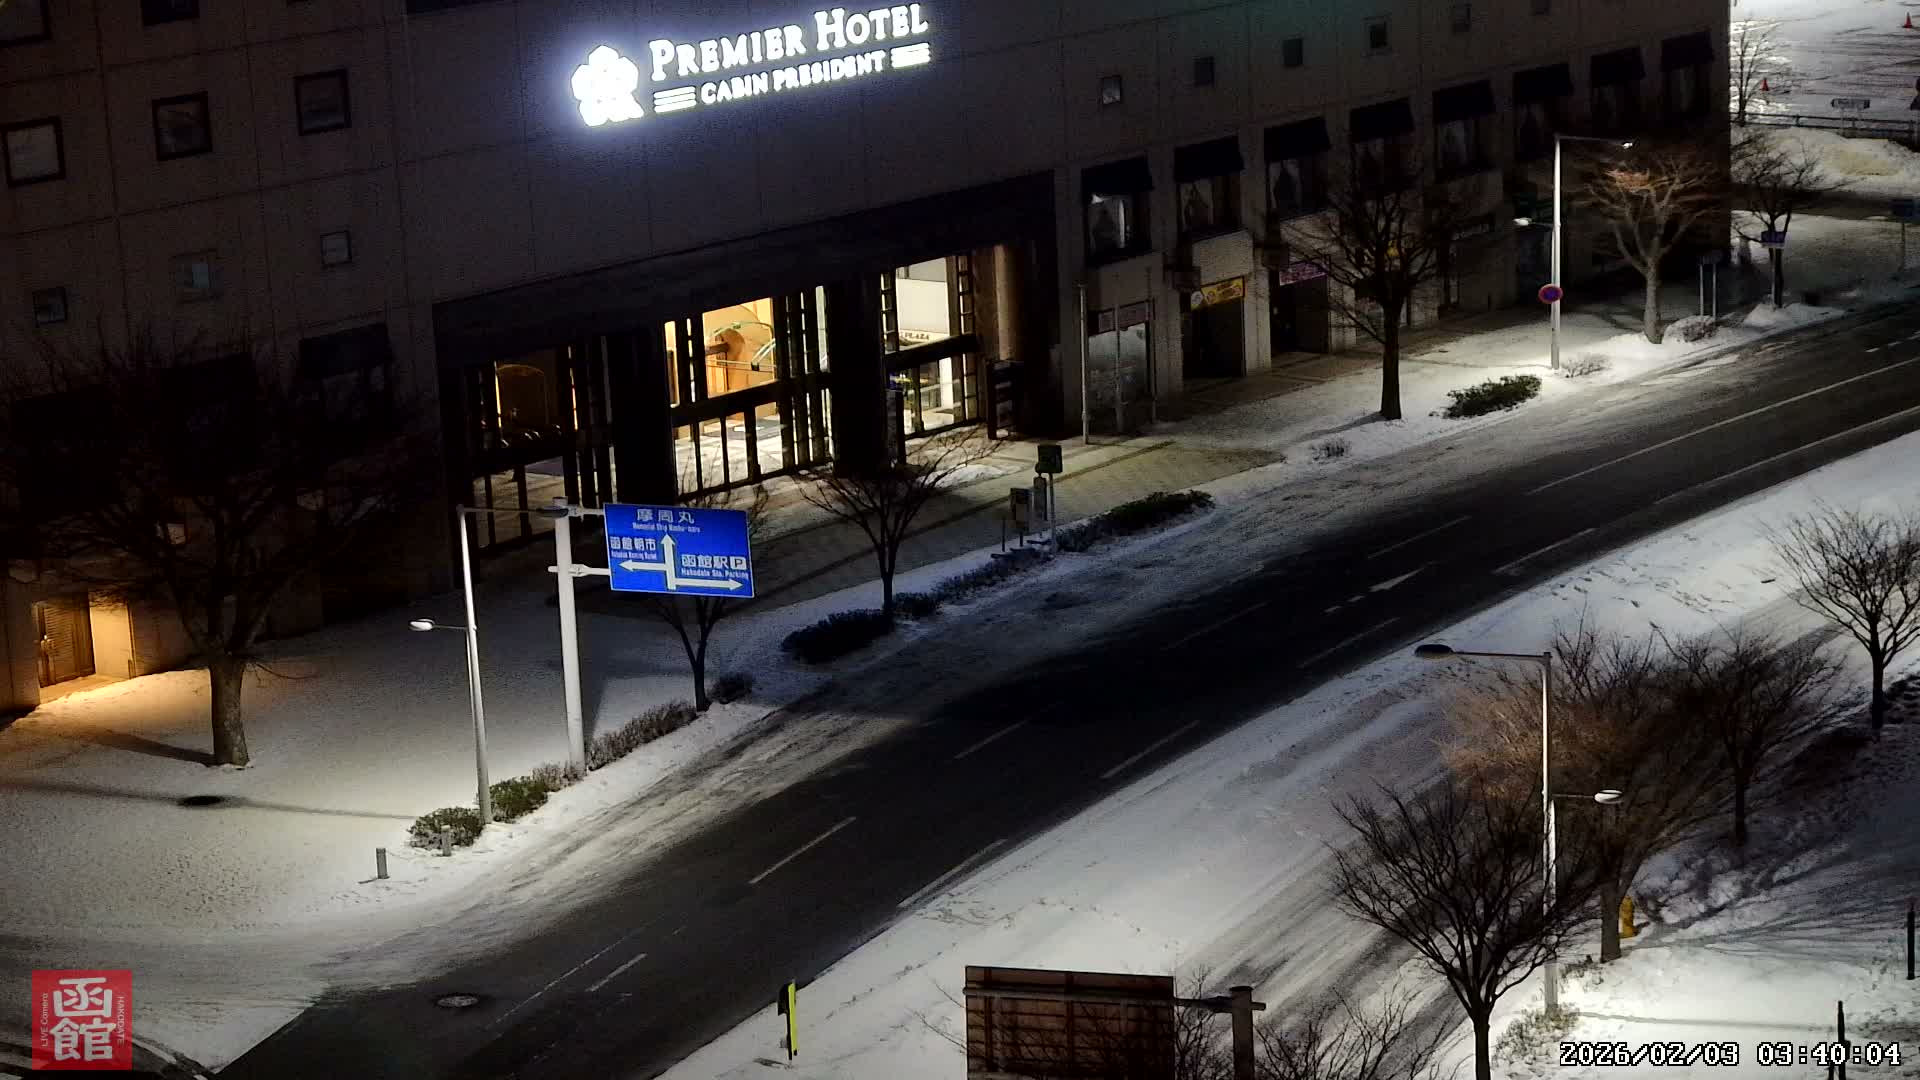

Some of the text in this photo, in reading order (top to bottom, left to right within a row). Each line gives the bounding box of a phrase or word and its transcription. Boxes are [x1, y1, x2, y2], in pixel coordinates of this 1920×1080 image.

[649, 3, 929, 81] PREMIER HOTEL
[701, 50, 887, 105] CABIN PRESIDENT
[637, 509, 695, 524] 摩周丸
[610, 536, 656, 551] 函館朝市
